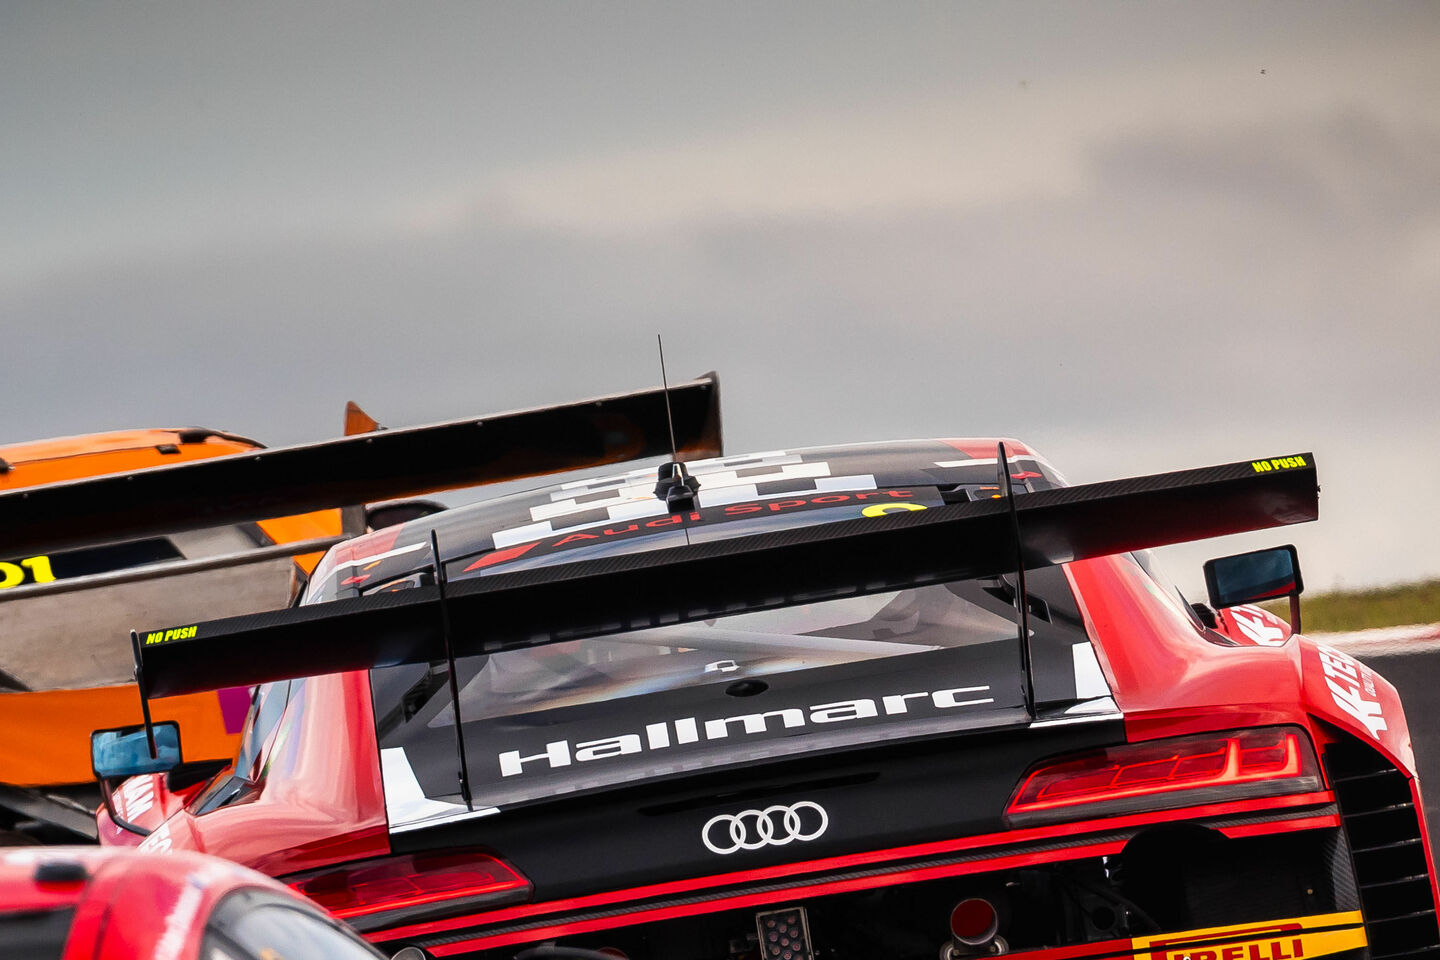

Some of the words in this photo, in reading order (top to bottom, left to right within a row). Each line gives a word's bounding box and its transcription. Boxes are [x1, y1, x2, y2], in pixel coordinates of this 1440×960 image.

[1251, 460, 1272, 473] NO
[1270, 456, 1307, 470] PUSH
[551, 510, 702, 547] Audi
[724, 488, 915, 517] Sport
[145, 631, 164, 645] NO
[164, 625, 198, 642] PUSH
[498, 685, 995, 777] Hallmarc
